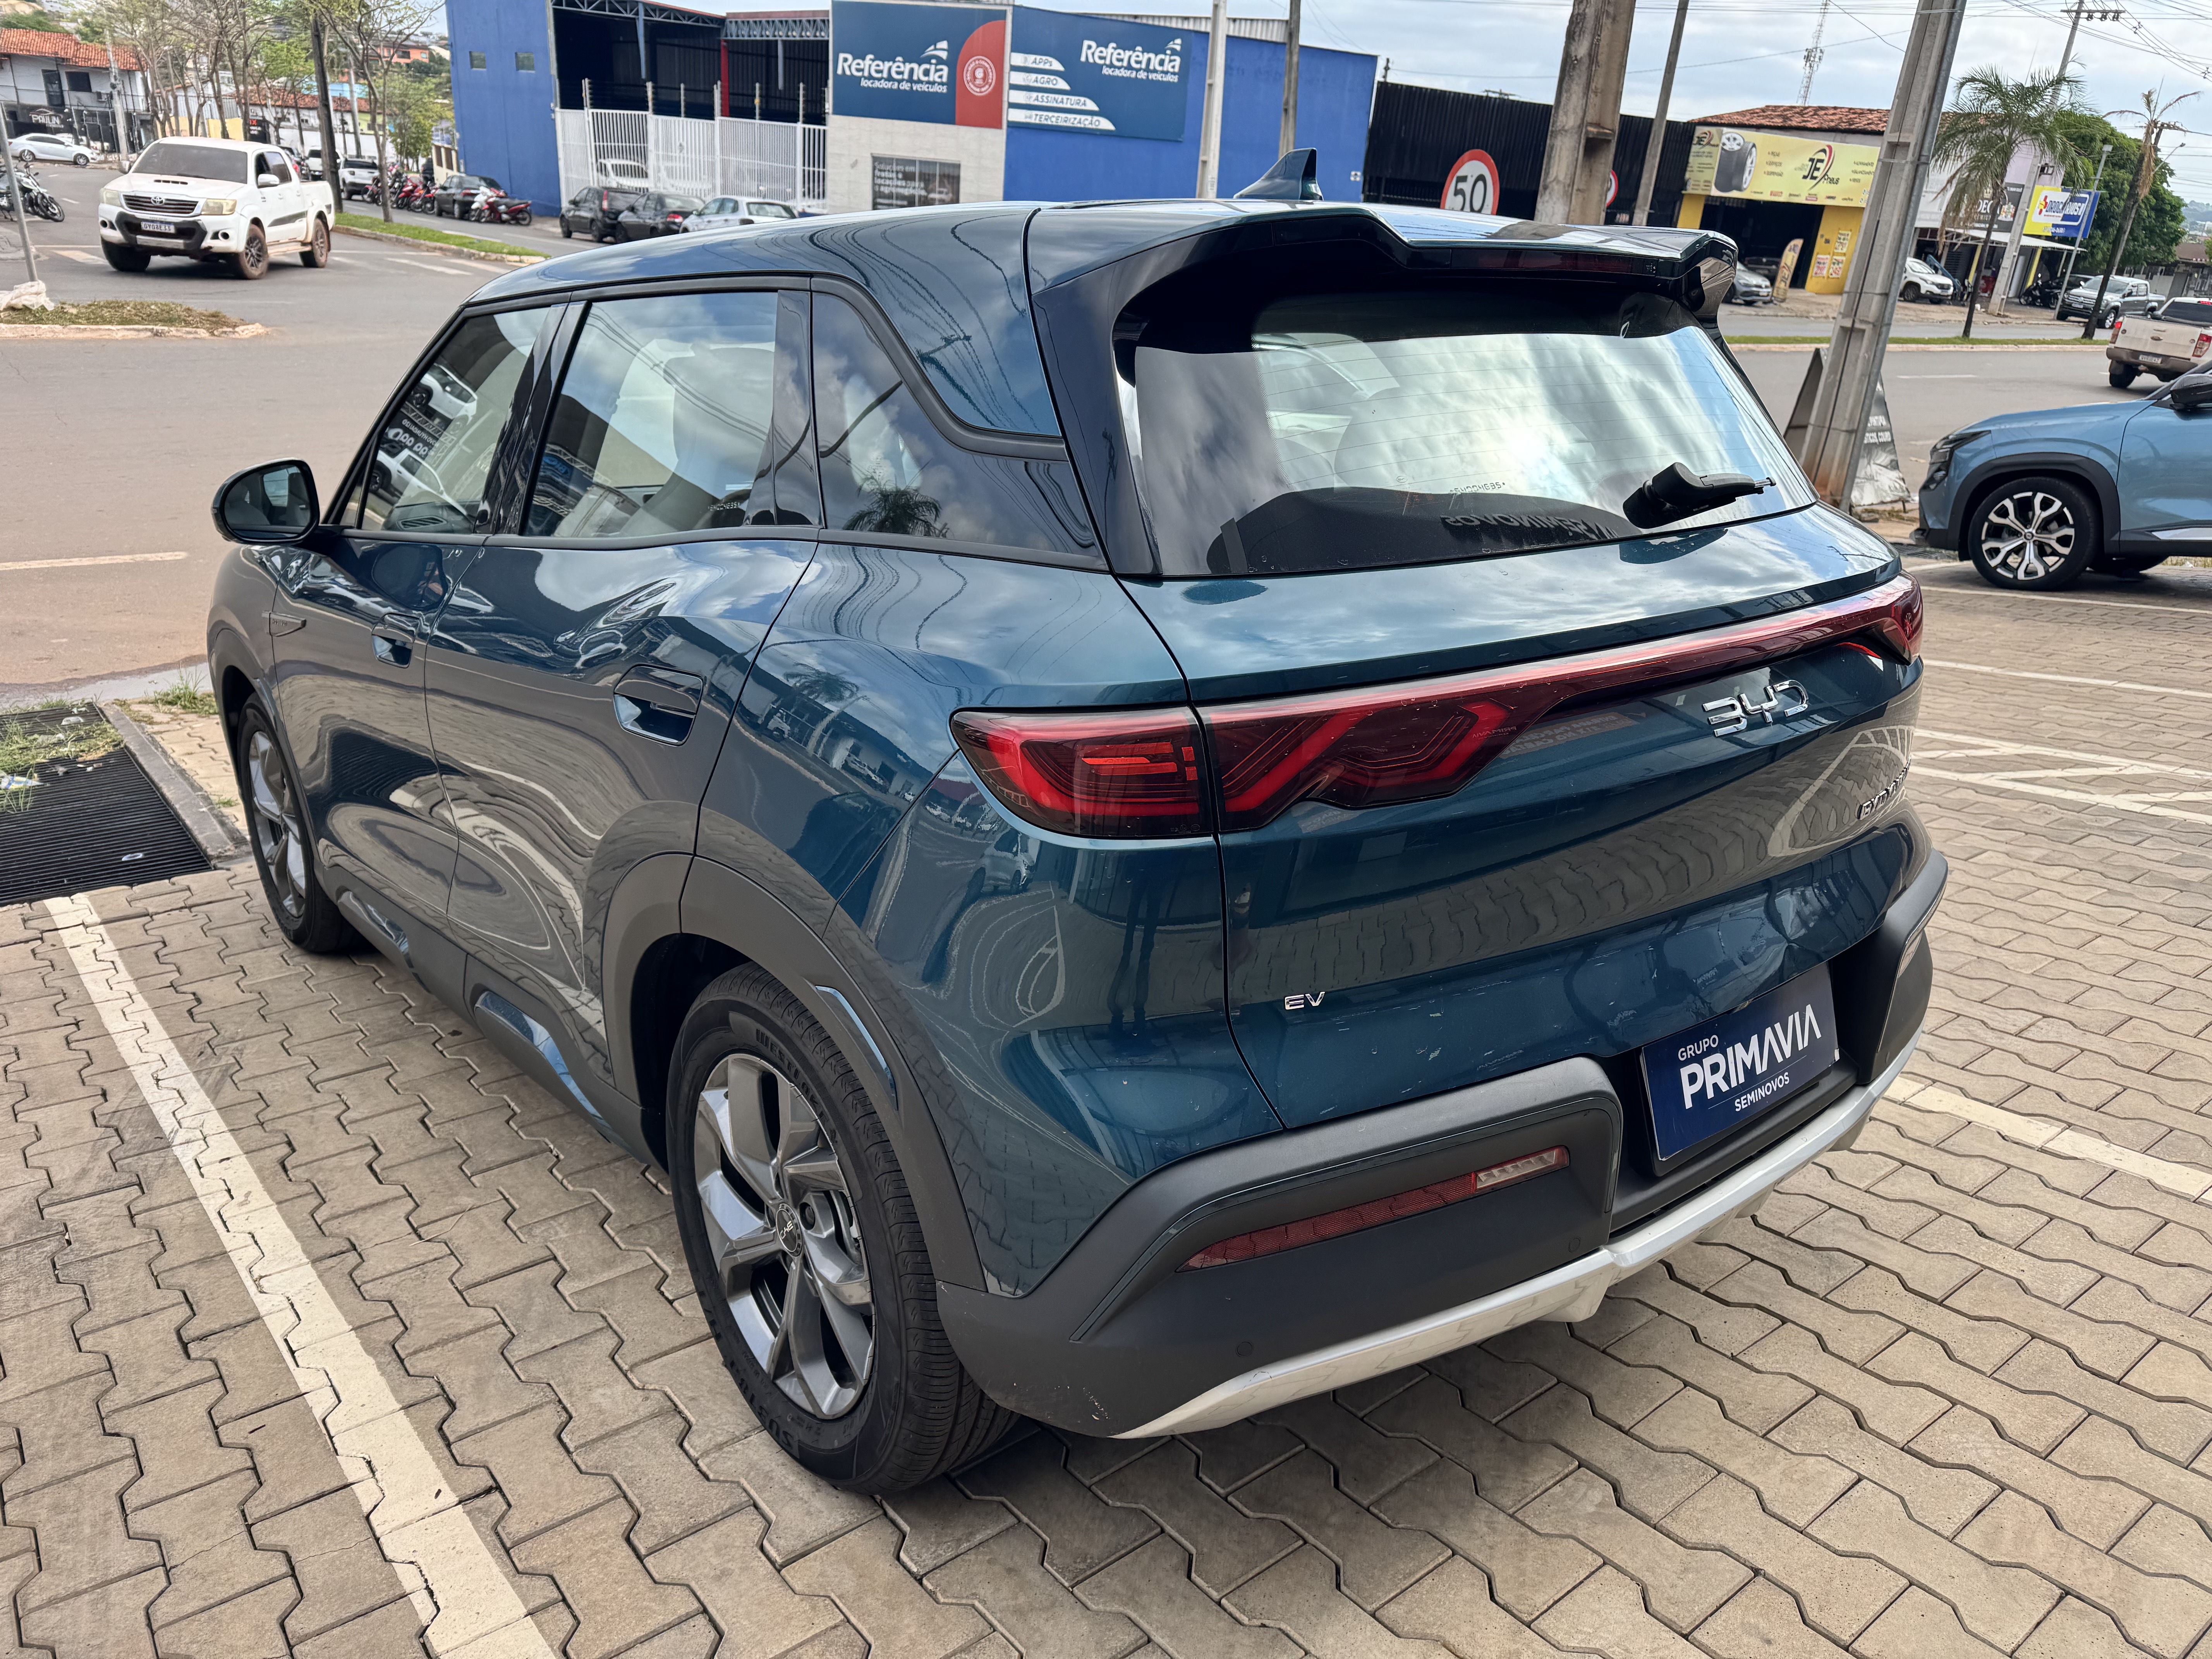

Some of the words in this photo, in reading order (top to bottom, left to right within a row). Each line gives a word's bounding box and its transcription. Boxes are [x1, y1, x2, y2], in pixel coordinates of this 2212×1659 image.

[836, 53, 948, 82] Referência
[1080, 40, 1181, 72] Referência
[860, 78, 898, 89] locadora
[899, 81, 910, 90] de
[1032, 76, 1058, 86] AGRO
[1102, 65, 1136, 78] locadora
[1137, 70, 1148, 79] de
[1033, 95, 1087, 107] ASSINATURA
[1454, 173, 1487, 213] 50
[1702, 680, 1809, 737] BYD
[1285, 991, 1325, 1010] EV
[1678, 1034, 1719, 1061] GRUPO
[1680, 1004, 1822, 1109] PRIMAVIA
[1735, 1072, 1790, 1112] SEMINOVOS
